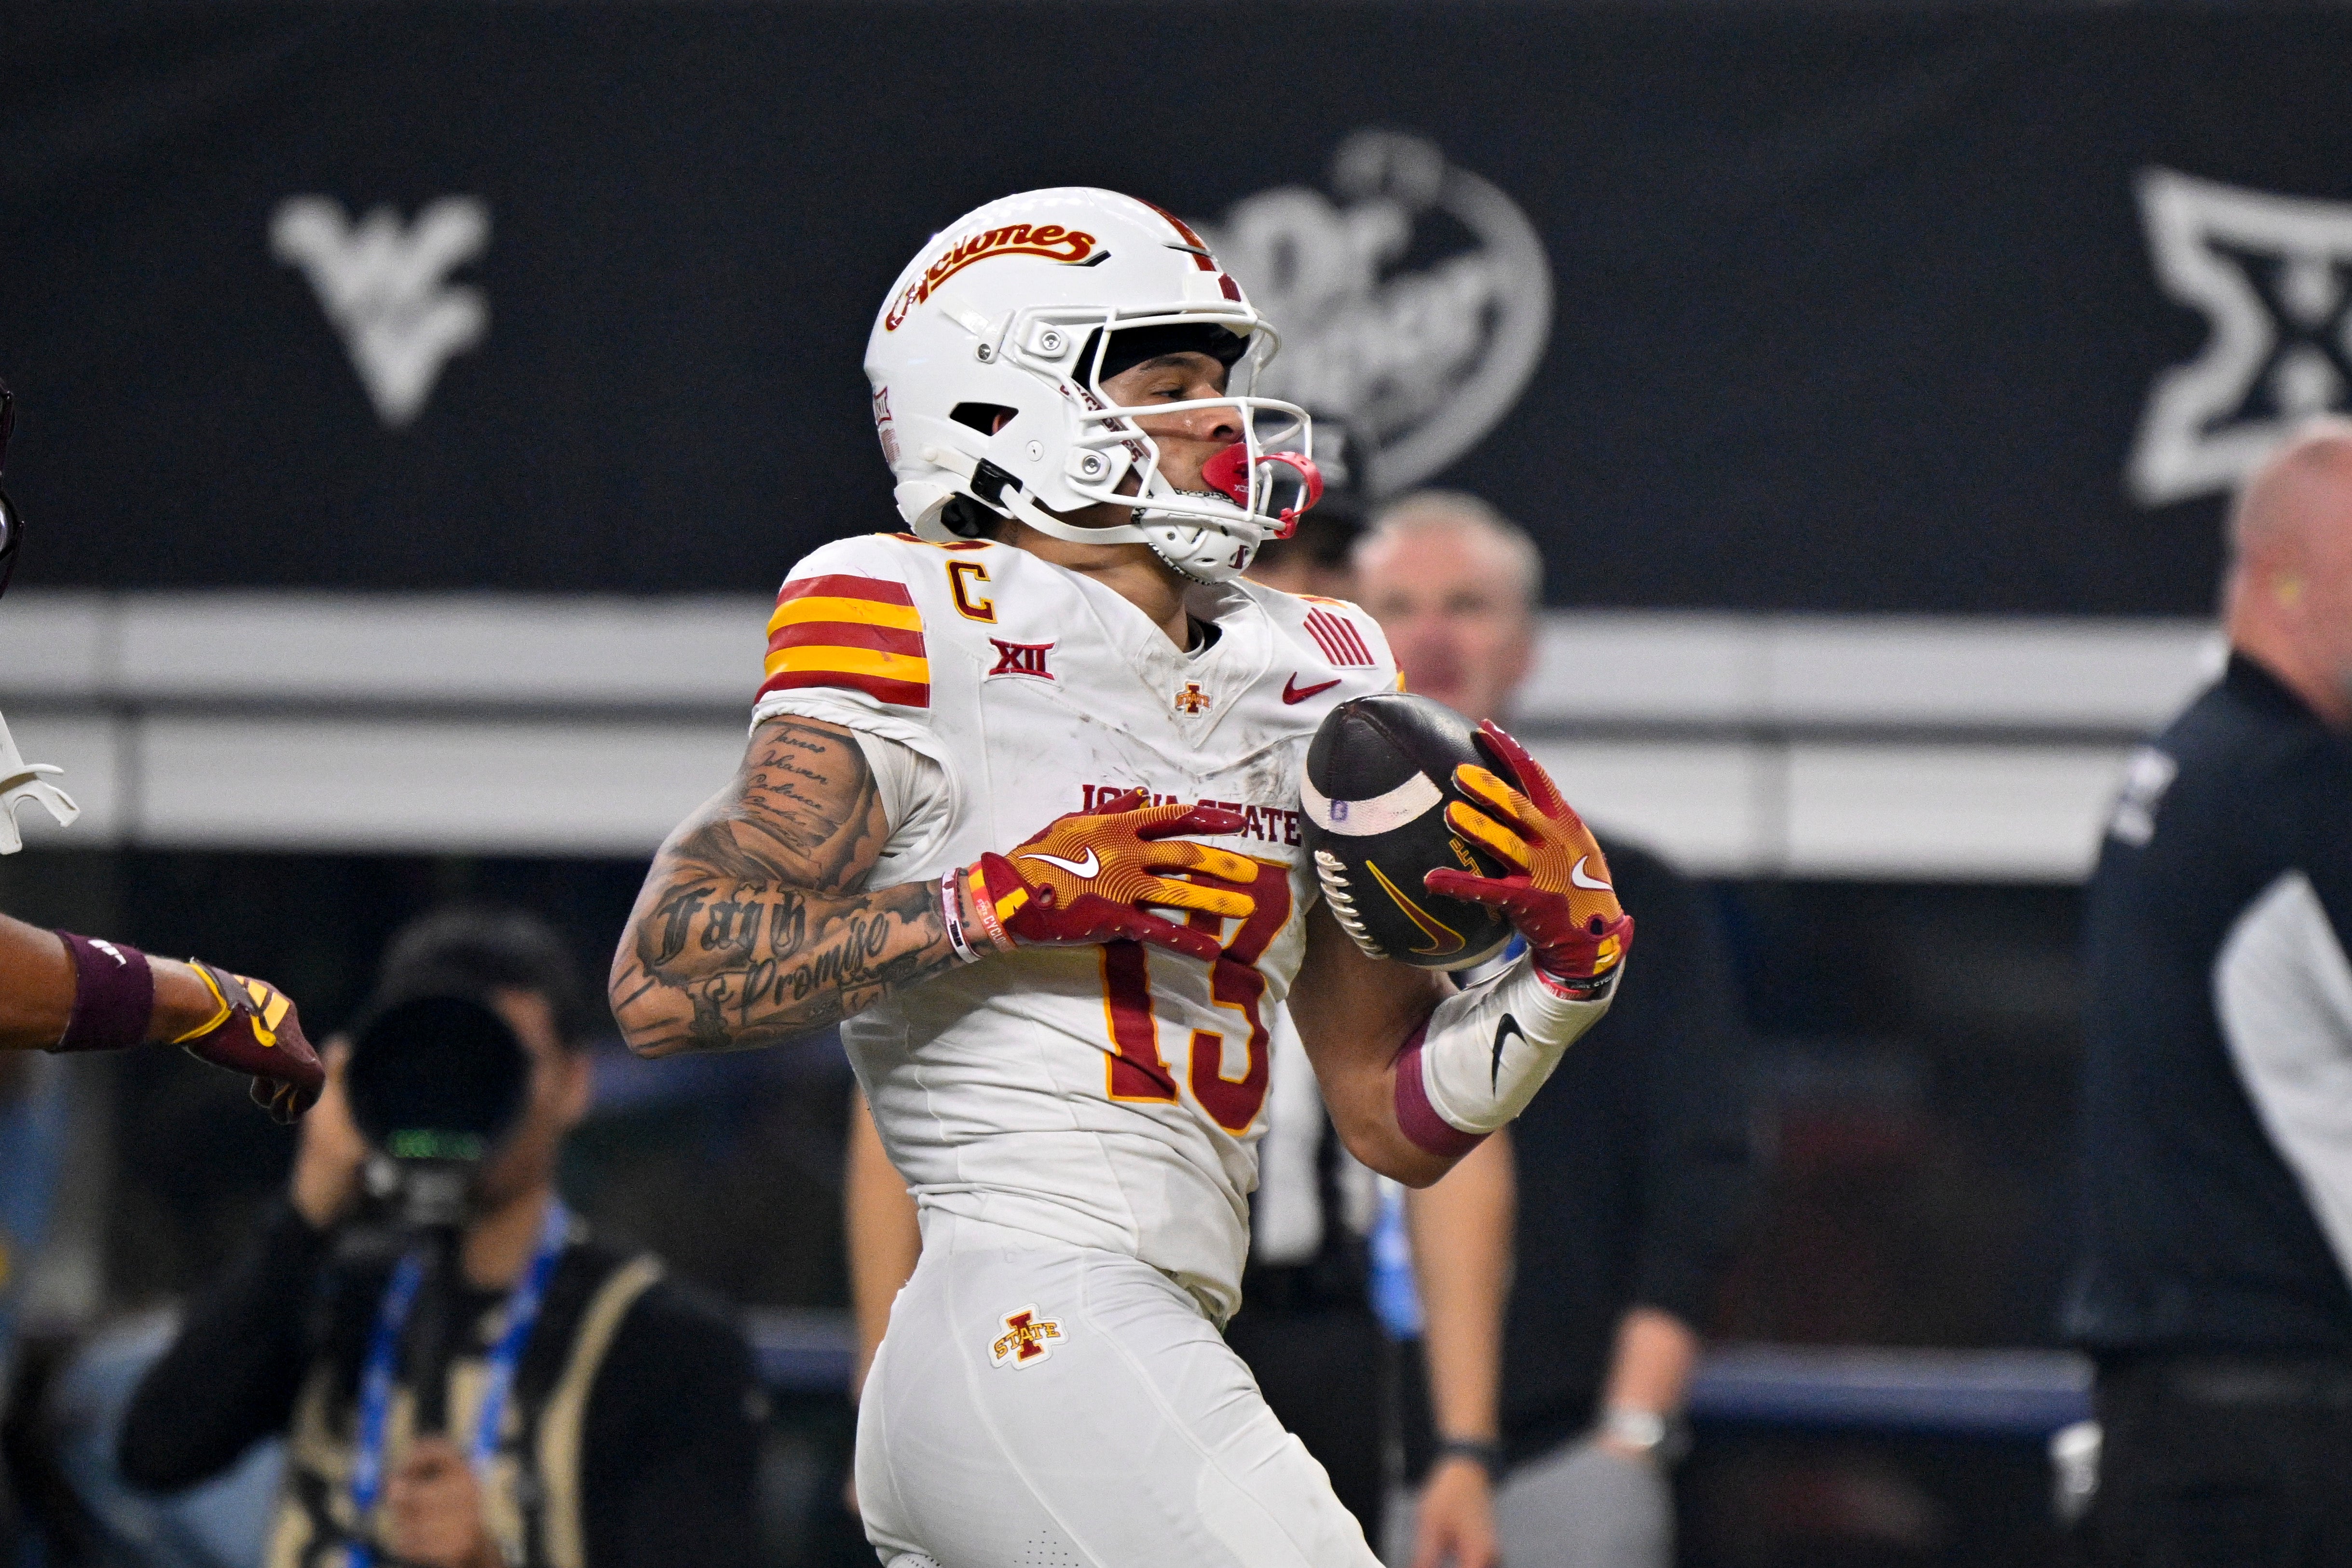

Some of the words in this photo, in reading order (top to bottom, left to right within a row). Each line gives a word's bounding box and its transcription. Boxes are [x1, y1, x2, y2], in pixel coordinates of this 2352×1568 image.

[886, 224, 1096, 332] Cyclones
[945, 559, 998, 624] C
[989, 638, 1055, 681] XII
[1197, 799, 1303, 846] ATE
[1099, 857, 1292, 1137] 13
[994, 1323, 1061, 1359] STATE
